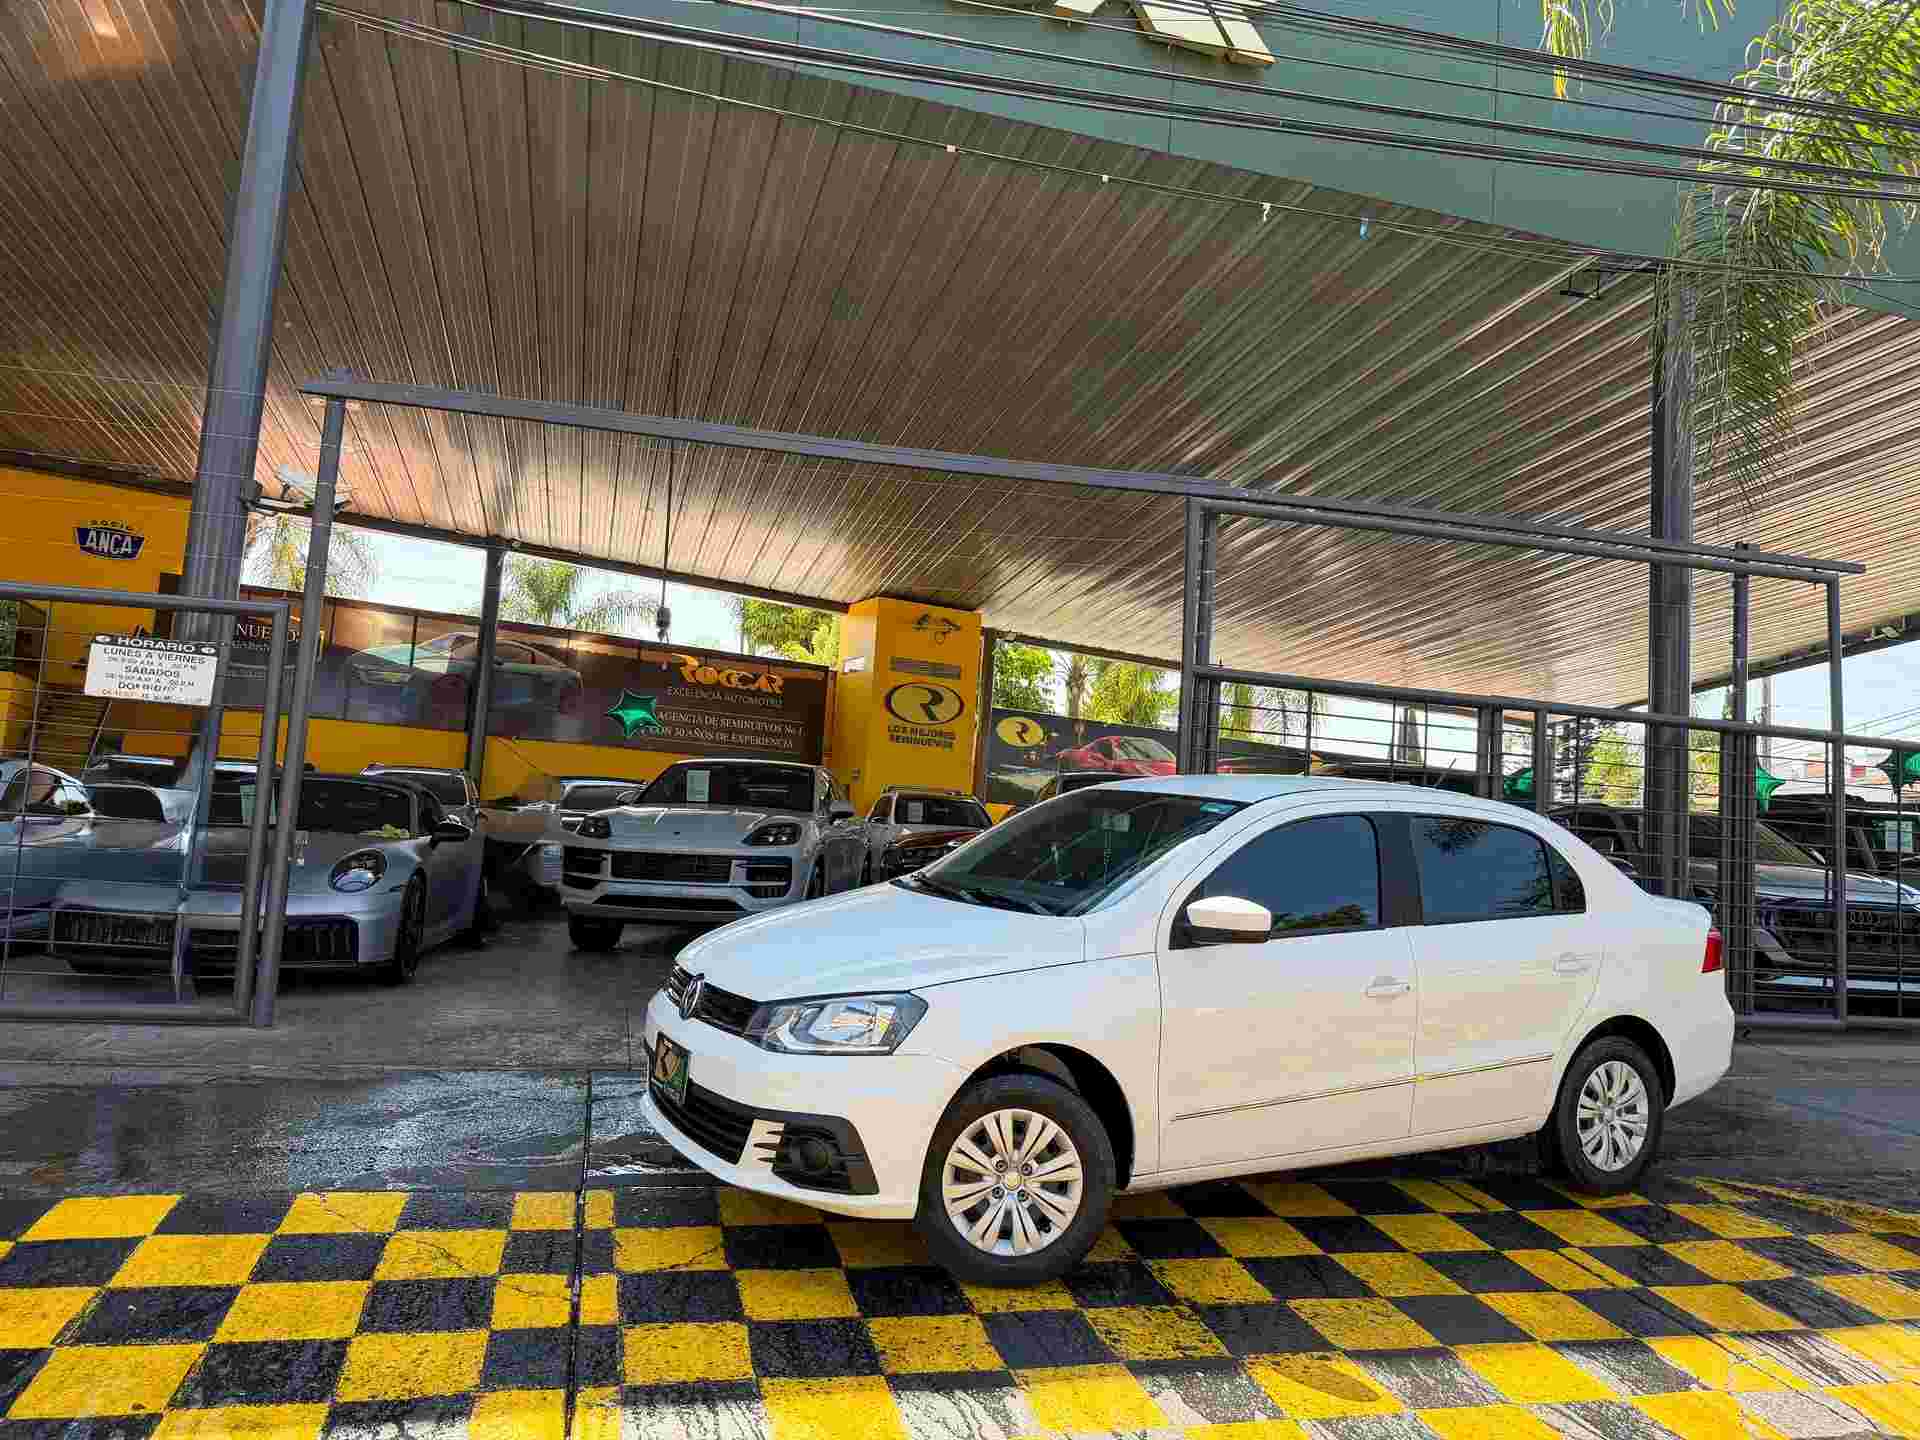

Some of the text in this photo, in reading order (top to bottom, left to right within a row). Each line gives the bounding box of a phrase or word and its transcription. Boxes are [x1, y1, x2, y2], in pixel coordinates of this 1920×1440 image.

[85, 527, 132, 554] ANCA
[117, 637, 196, 653] HORARIO
[103, 646, 142, 659] LUNES
[144, 651, 153, 659] A
[158, 653, 207, 665] VIERNES
